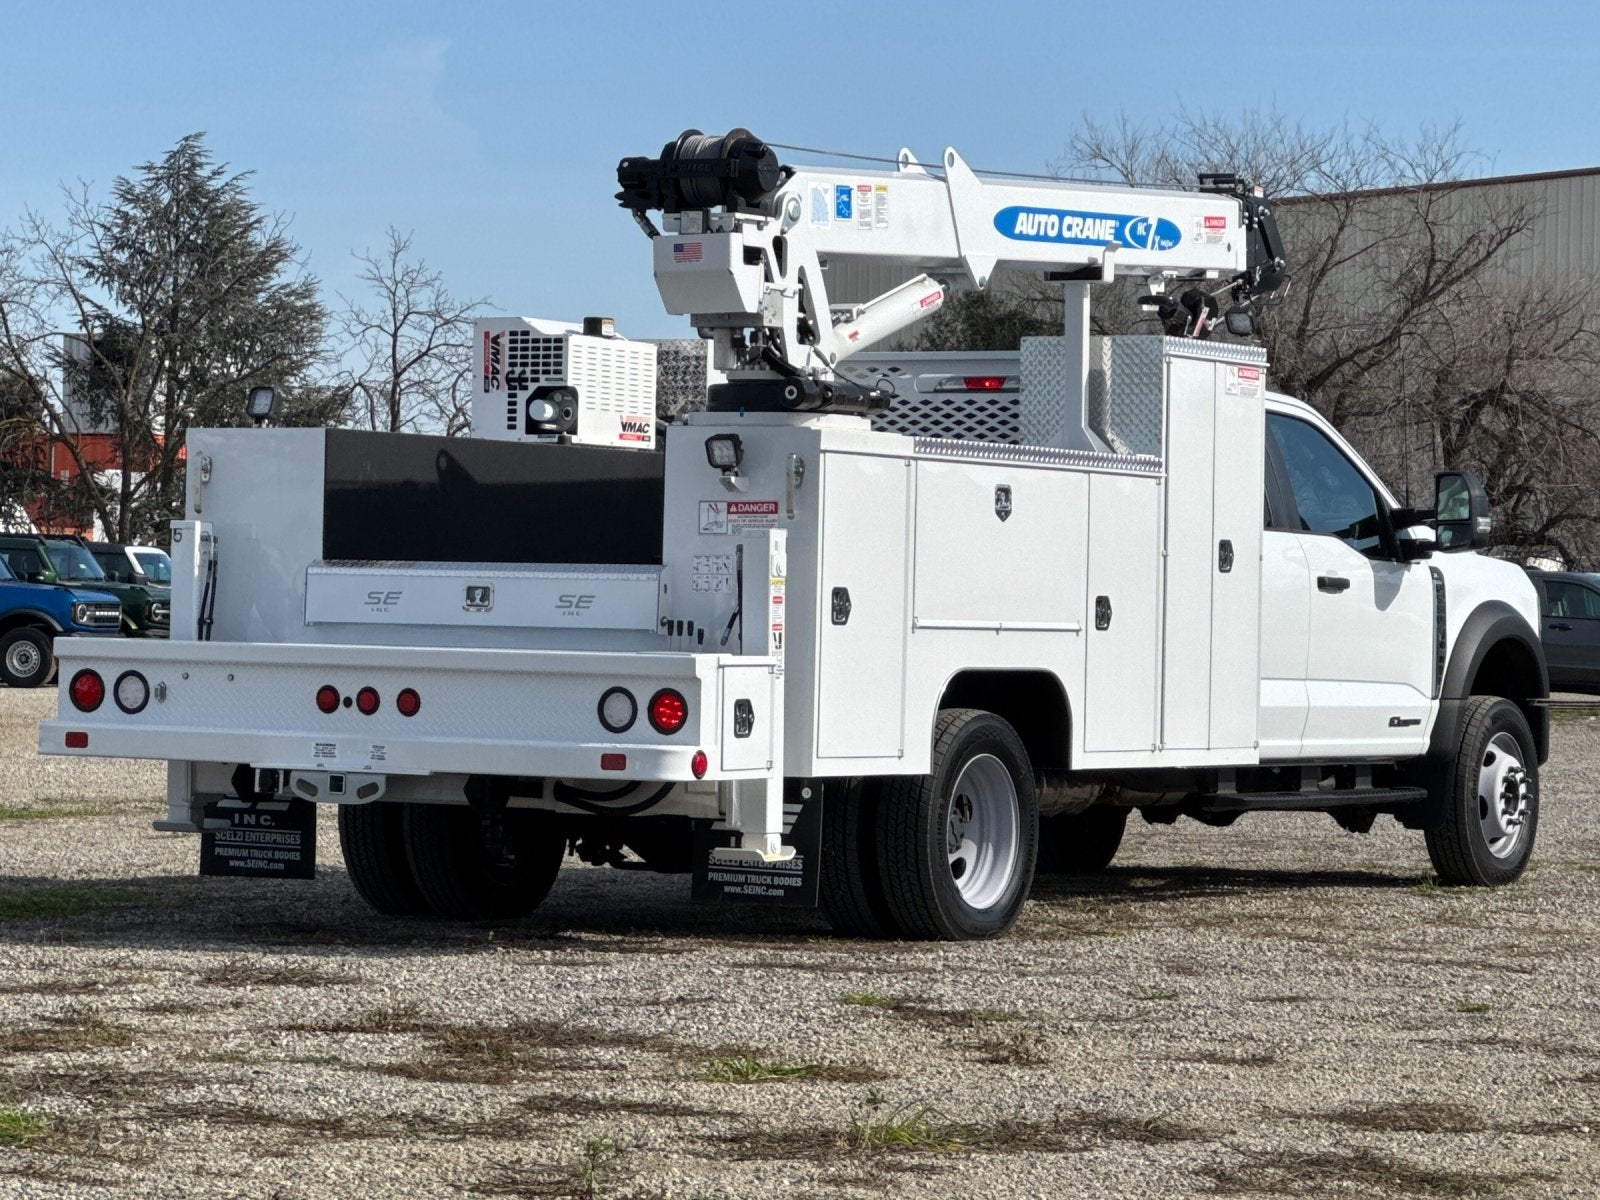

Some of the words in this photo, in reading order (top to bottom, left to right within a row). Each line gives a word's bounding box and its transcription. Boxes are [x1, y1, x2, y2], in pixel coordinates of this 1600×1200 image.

[1014, 212, 1060, 237] AUTO
[1062, 215, 1116, 241] CRANE
[490, 333, 500, 391] VMAC
[620, 421, 650, 434] VMAC
[738, 503, 776, 512] DANGER
[173, 528, 183, 543] 5
[364, 591, 402, 605] SE
[555, 594, 596, 609] SE
[234, 813, 276, 827] INC.
[215, 831, 243, 841] SCELZI
[245, 832, 301, 844] ENTERPRISES
[214, 847, 249, 857] PREMIUM
[249, 849, 273, 859] TRUCK
[274, 850, 301, 861] BODIES
[229, 859, 285, 870] www.SEINC.com
[708, 871, 746, 883] PREMIUM
[747, 874, 772, 885] TRUCK
[773, 876, 802, 887] BODIES
[723, 885, 785, 896] www.SEINC.com
